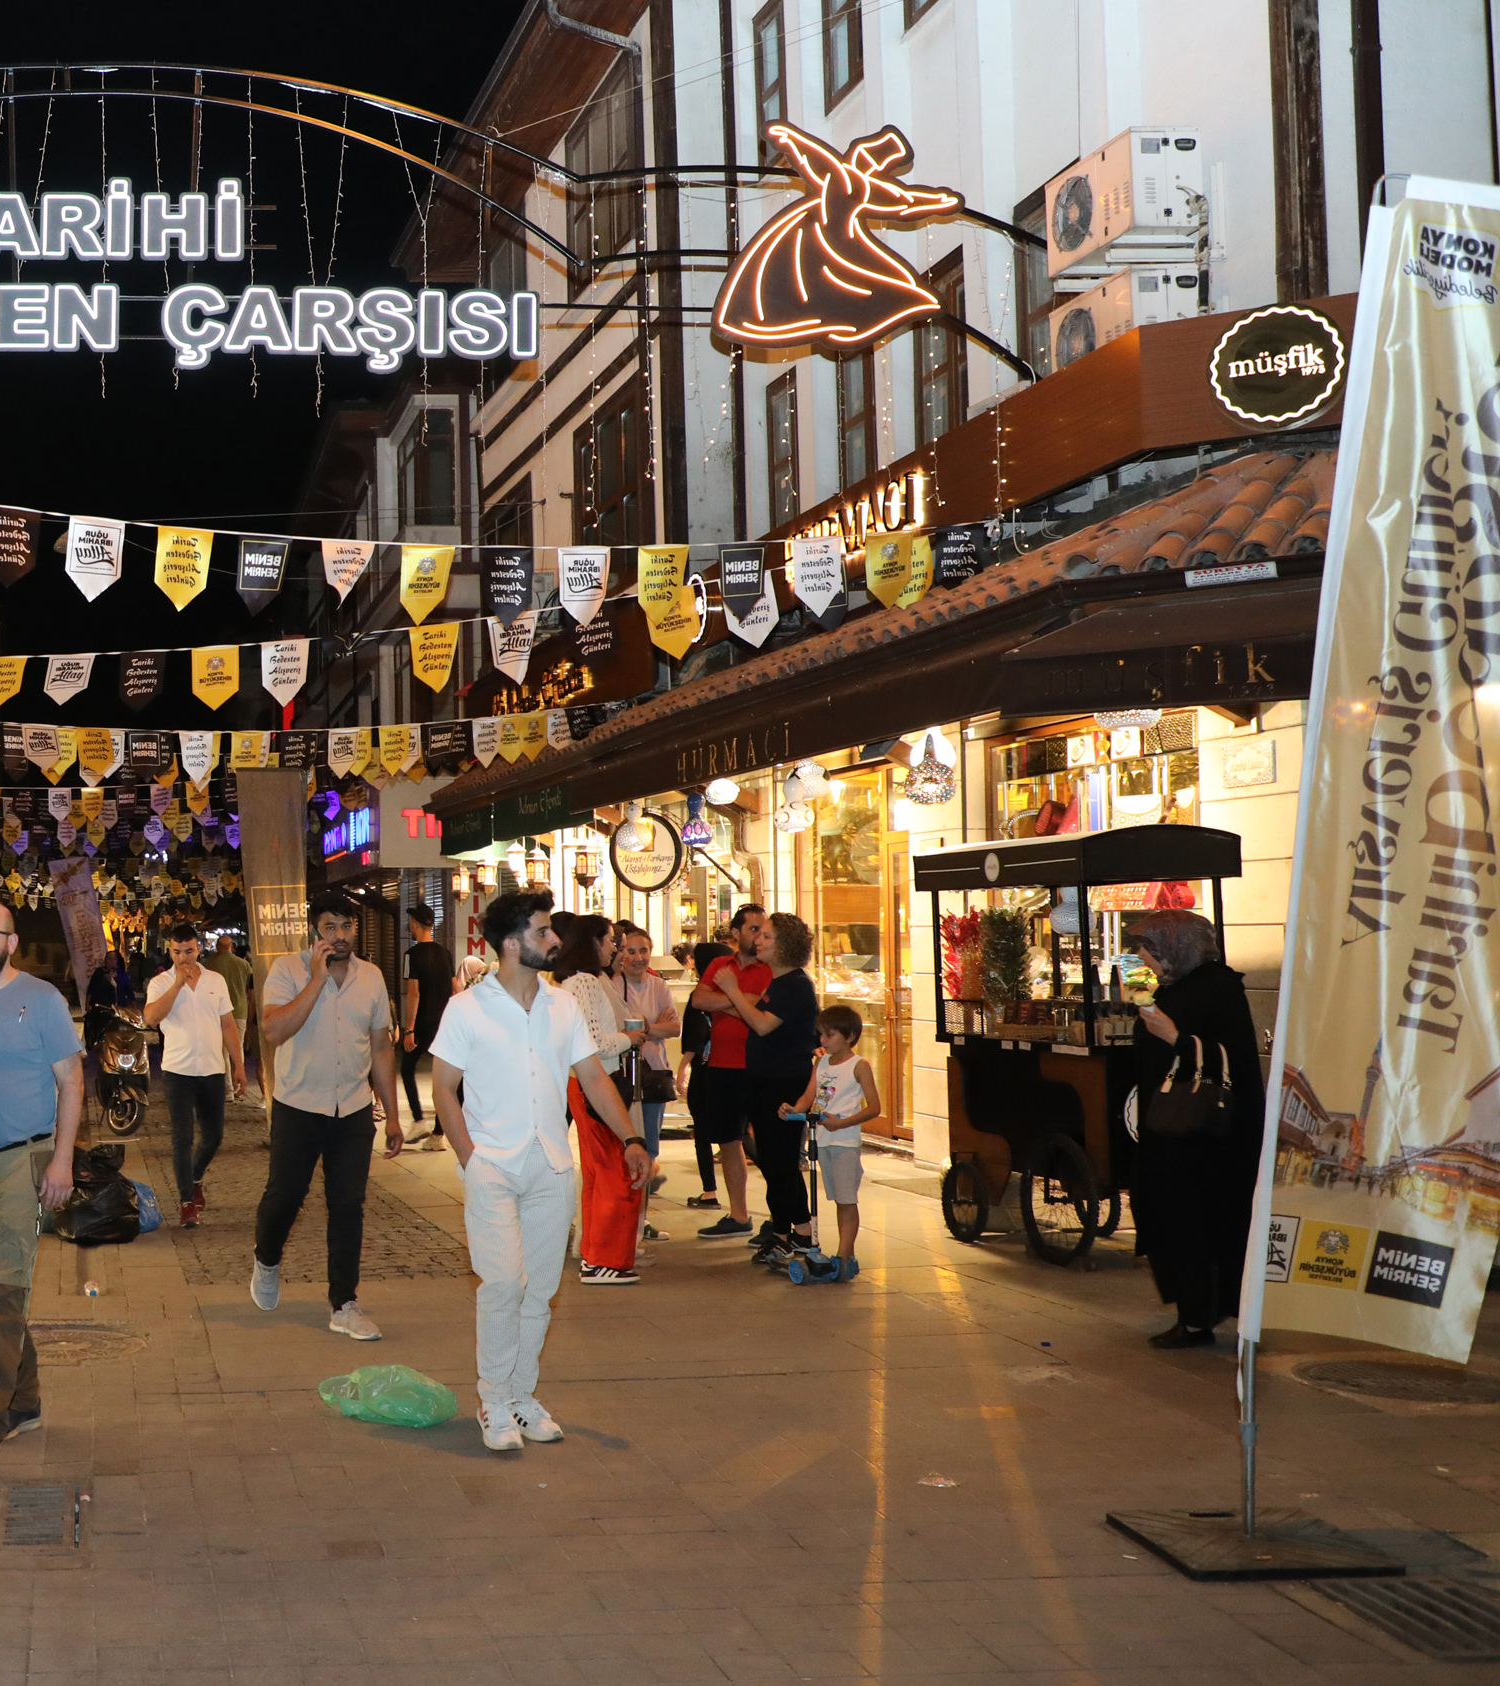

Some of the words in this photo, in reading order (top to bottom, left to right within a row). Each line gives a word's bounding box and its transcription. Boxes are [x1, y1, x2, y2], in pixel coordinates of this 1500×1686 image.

[163, 285, 540, 372] ÇARŞISI
[1228, 343, 1324, 378] müşfik
[1301, 365, 1326, 377] 1975
[422, 631, 447, 641] Tarihi
[576, 631, 613, 645] Alışveriş
[274, 644, 297, 652] Tarihi
[419, 642, 452, 652] Bedesten
[500, 637, 533, 655] Altay
[582, 641, 611, 655] Günleri
[131, 658, 154, 667] Tarihi
[269, 655, 301, 664] Bedesten
[268, 667, 301, 675] Alışveriş
[422, 663, 450, 673] Günleri
[272, 677, 298, 686] Günleri
[126, 687, 154, 696] Günleri
